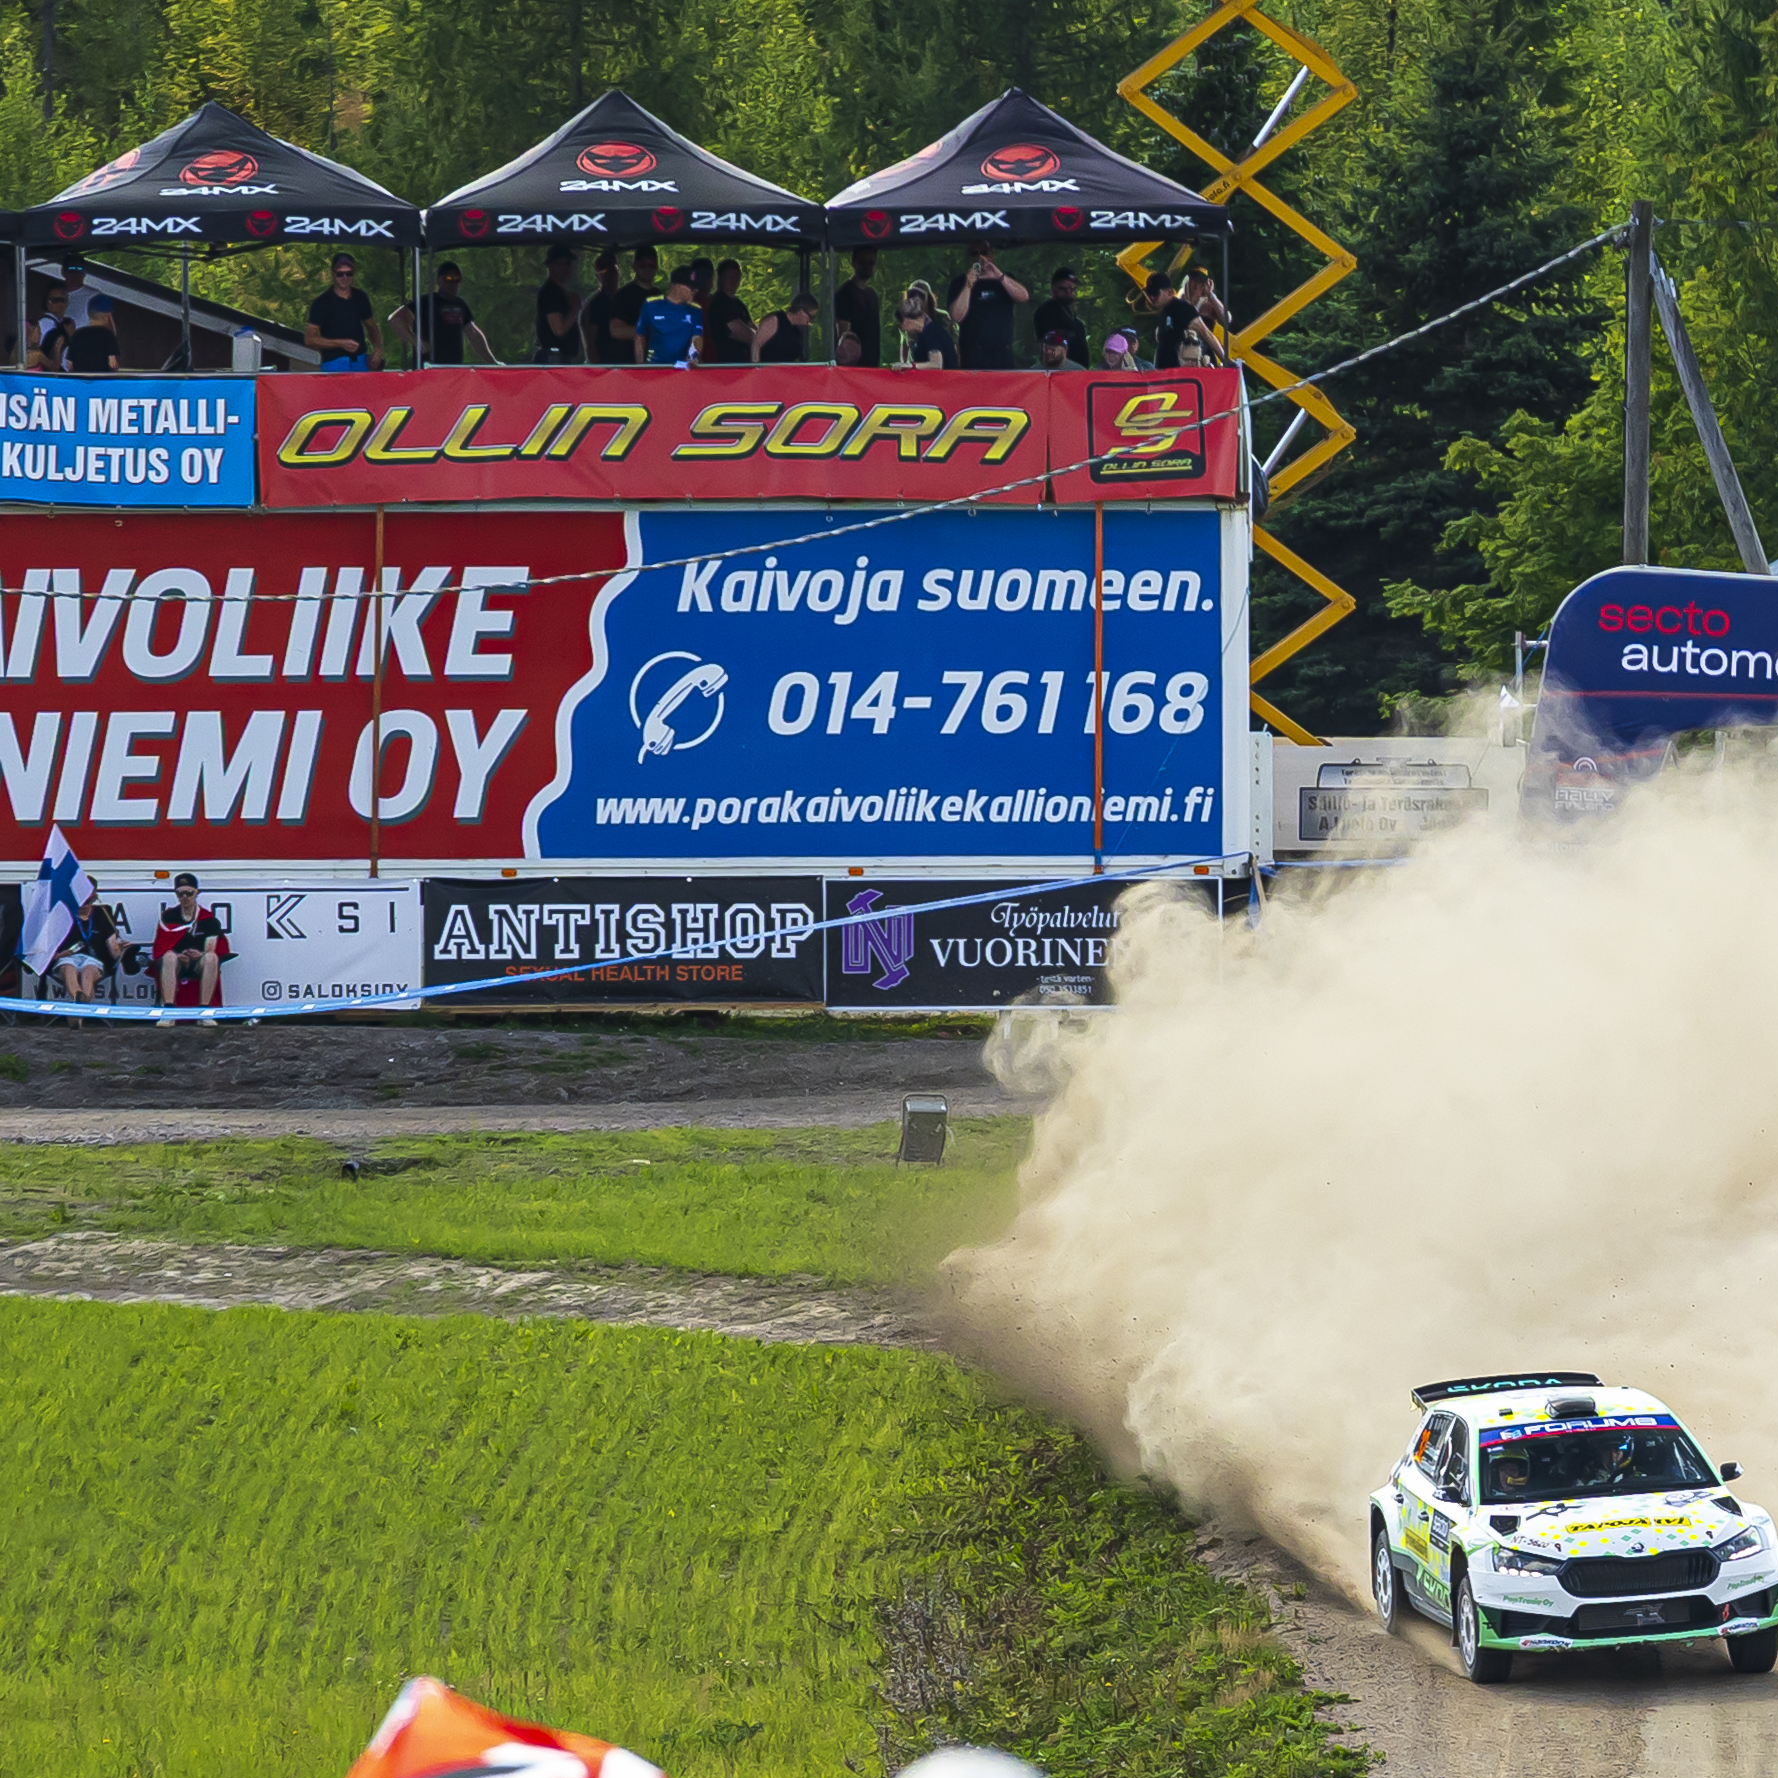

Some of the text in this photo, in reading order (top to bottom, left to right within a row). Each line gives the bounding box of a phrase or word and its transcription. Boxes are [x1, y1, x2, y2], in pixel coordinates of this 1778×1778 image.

[159, 183, 279, 196] 24MX
[559, 179, 679, 193] 24MX
[961, 178, 1080, 194] 24MX
[92, 216, 202, 234] 24MX
[284, 217, 394, 238] 24MX
[496, 213, 607, 232] 24MX
[691, 212, 800, 232] 24MX
[900, 211, 1010, 232] 24MX
[1090, 211, 1195, 229] 24MX
[88, 398, 240, 435] METALLI-
[278, 401, 1031, 468] OLLIN SORA
[2, 441, 224, 484] KULJETUS OY
[676, 555, 1215, 625] Kaivoja suomeen.
[0, 567, 530, 681] IVOLIIKE
[1599, 600, 1731, 637] secto
[767, 670, 1209, 736] 014-761 168
[348, 709, 530, 822] OY
[434, 903, 814, 960] ANTISHOP
[591, 965, 669, 981] HEALTH
[676, 964, 743, 981] STORE
